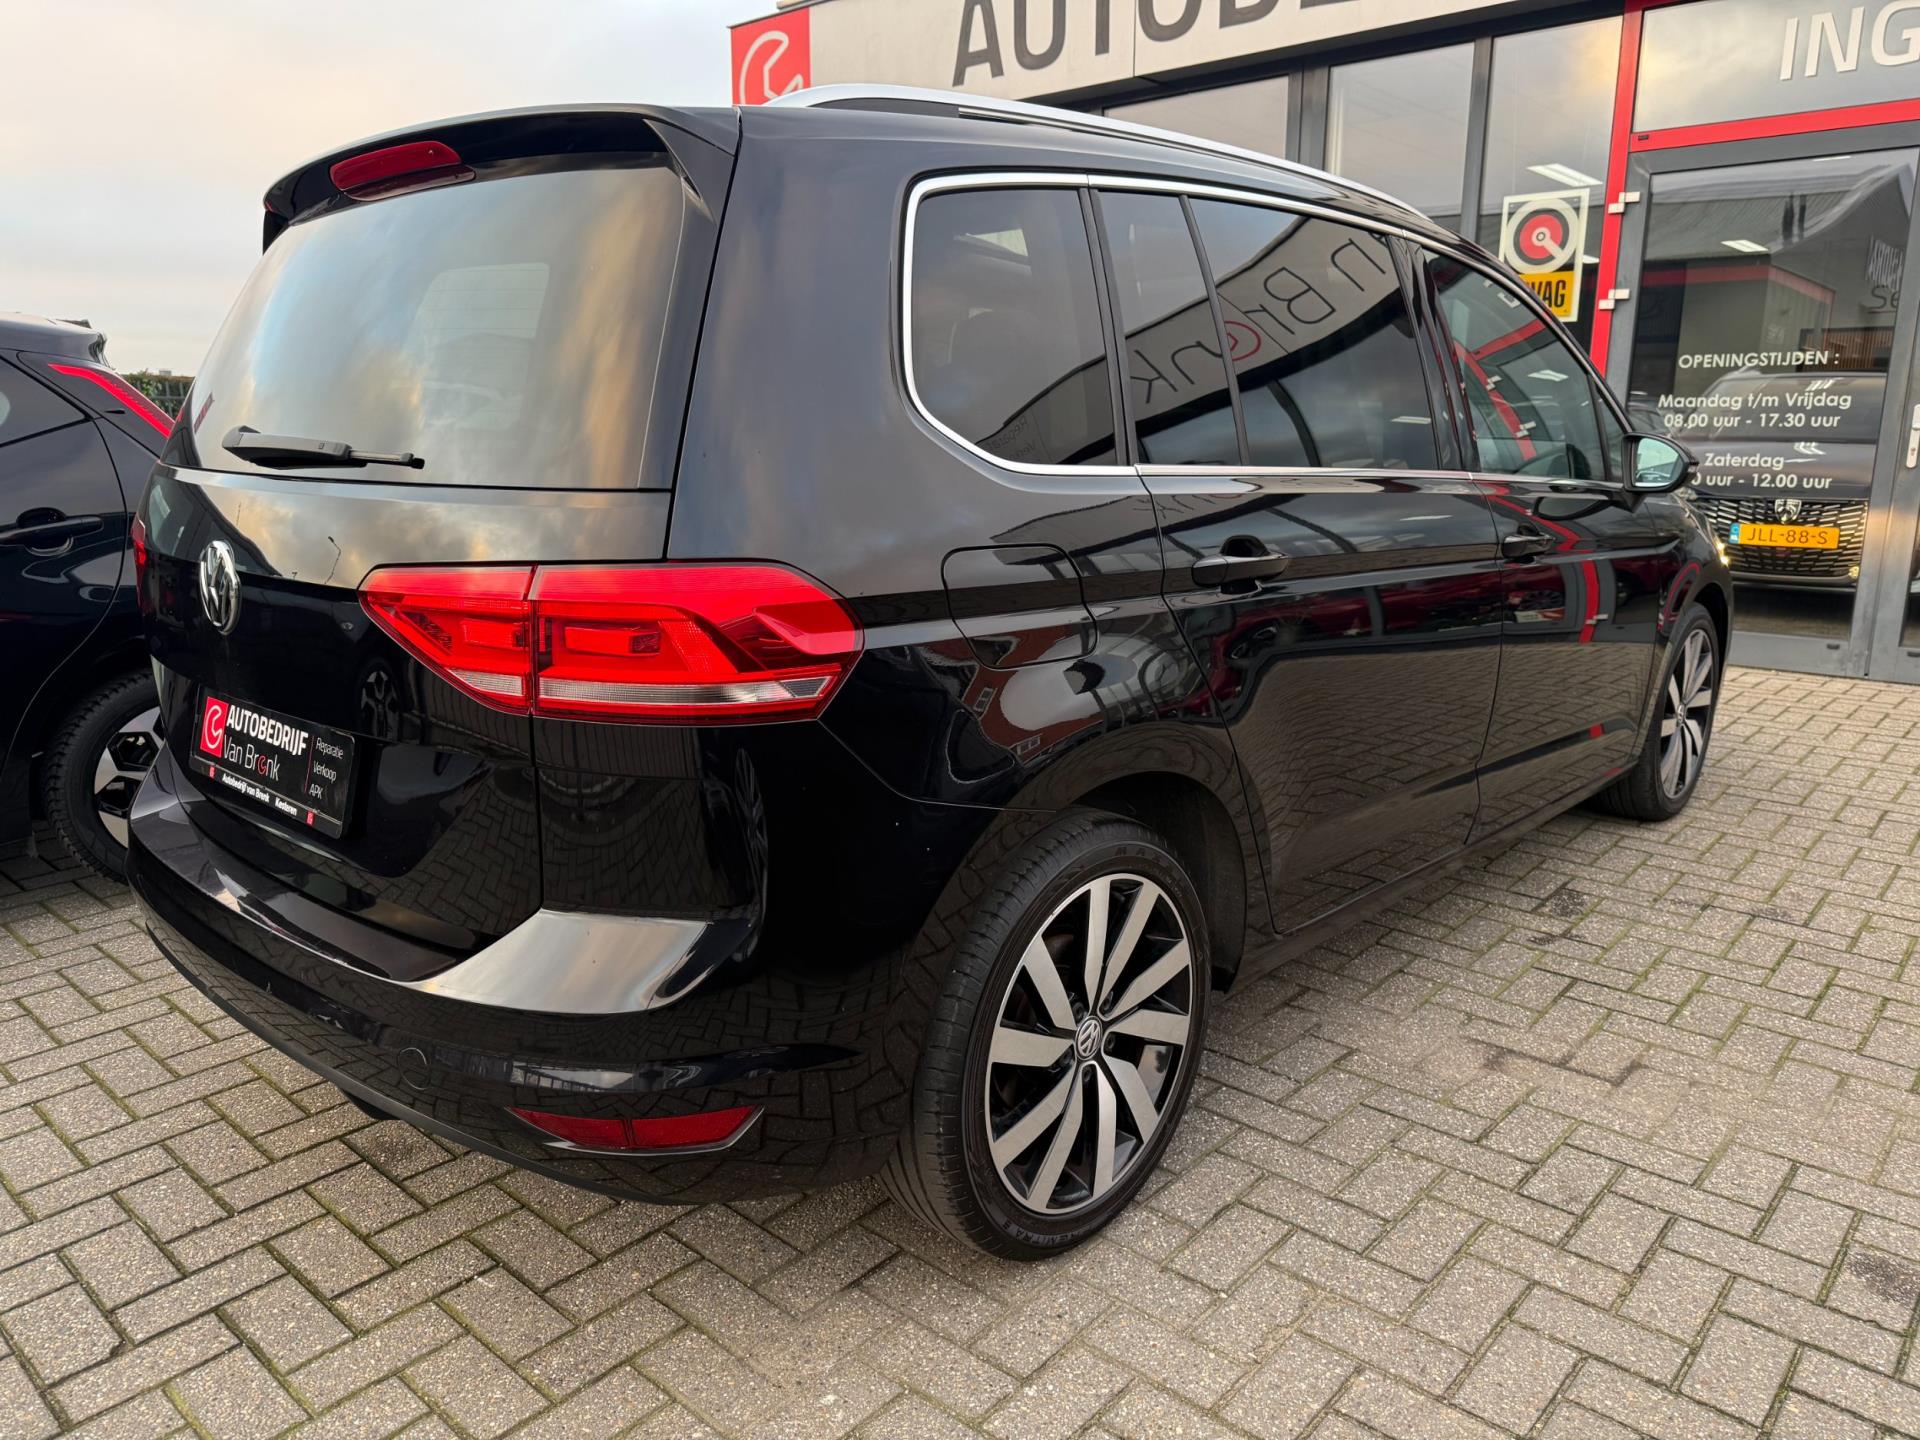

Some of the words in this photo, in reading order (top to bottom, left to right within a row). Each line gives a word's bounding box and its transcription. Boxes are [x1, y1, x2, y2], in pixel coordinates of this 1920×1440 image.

[952, 0, 1361, 87] AUT
[1526, 279, 1567, 308] VAG
[1678, 350, 1829, 369] OPENINGSTIJDEN
[1658, 394, 1742, 410] Maandag
[1747, 392, 1779, 410] t/m
[1785, 391, 1852, 410] Vrijdag
[1664, 414, 1708, 429] 08.00
[1713, 416, 1740, 428] uur
[1759, 413, 1805, 428] 17.30
[1811, 415, 1840, 428] uur
[1704, 452, 1785, 471] Zaterdag
[1706, 475, 1733, 487] uur
[1752, 473, 1798, 488] 12.00
[1803, 475, 1832, 489] uur
[1747, 528, 1829, 545] JLL-88-S
[226, 704, 309, 755] AUTOBEDRIJF
[224, 734, 243, 765] Van
[316, 737, 344, 760] Reparatie
[313, 760, 337, 782] Verkoop
[309, 783, 324, 800] APK
